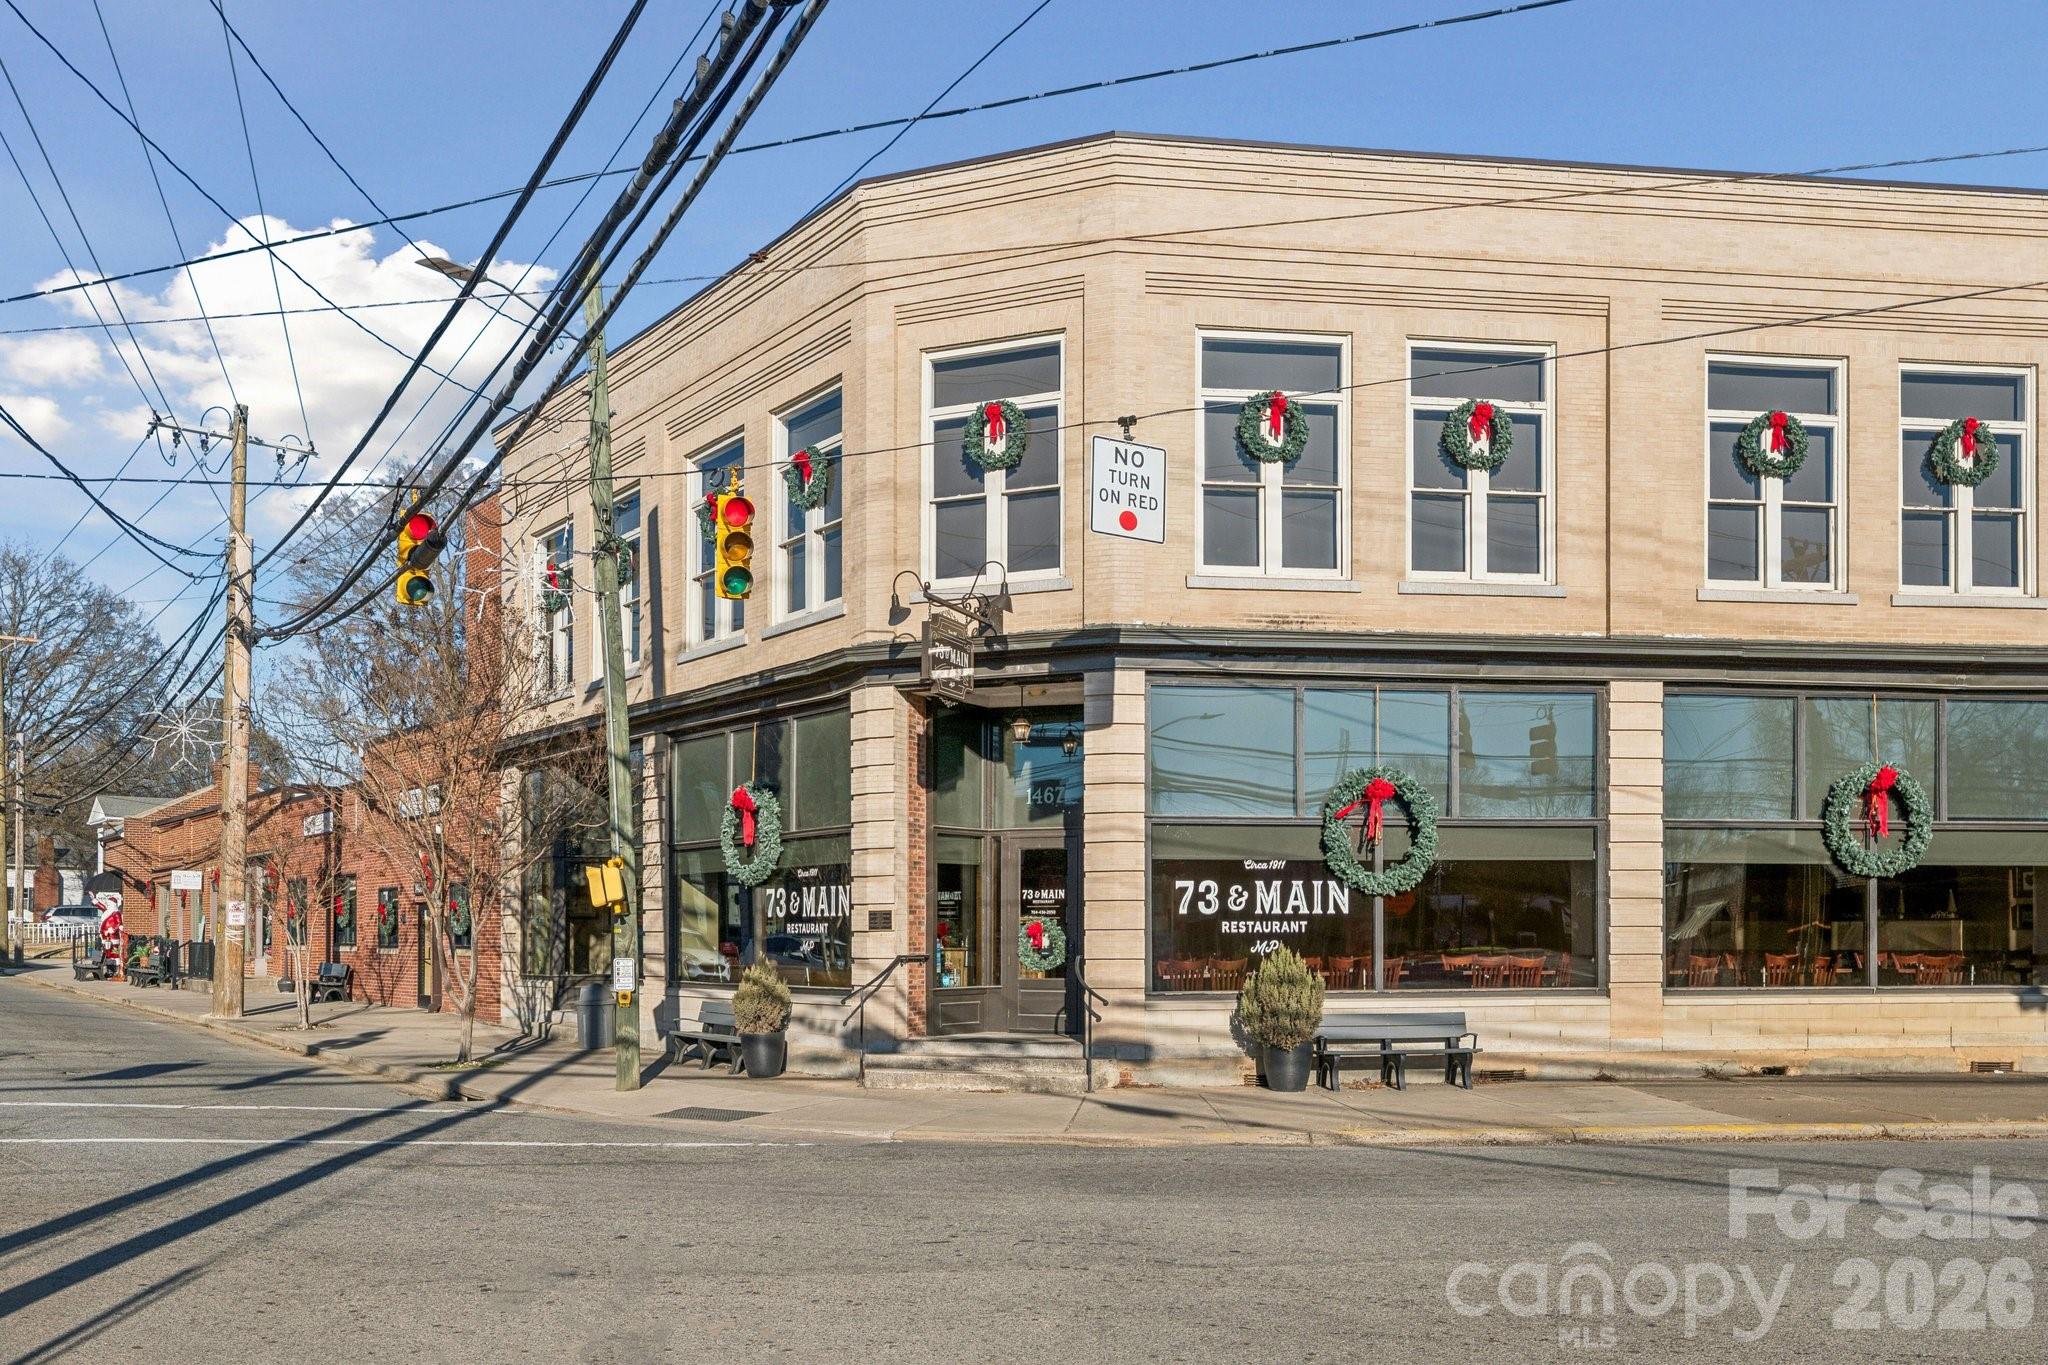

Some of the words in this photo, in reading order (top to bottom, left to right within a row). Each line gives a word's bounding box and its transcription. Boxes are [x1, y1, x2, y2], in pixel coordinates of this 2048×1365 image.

[1114, 446, 1144, 468] NO
[1109, 469, 1150, 490] TURN
[1099, 488, 1120, 504] ON
[1128, 493, 1158, 511] RED
[950, 648, 969, 668] MAIN
[1026, 786, 1065, 805] 1467
[1244, 859, 1268, 869] Circa
[1268, 859, 1286, 869] 1911
[766, 887, 786, 918] 73
[789, 891, 800, 915] &
[802, 885, 851, 918] MAIN
[1022, 889, 1034, 900] 73
[1034, 890, 1041, 899] &
[1041, 889, 1065, 899] MAIN
[1175, 880, 1219, 915] 73
[1227, 885, 1249, 912] &
[1254, 880, 1349, 915] MAIN
[786, 923, 829, 934] RESTAURANT
[1221, 921, 1308, 933] RESTAURANT
